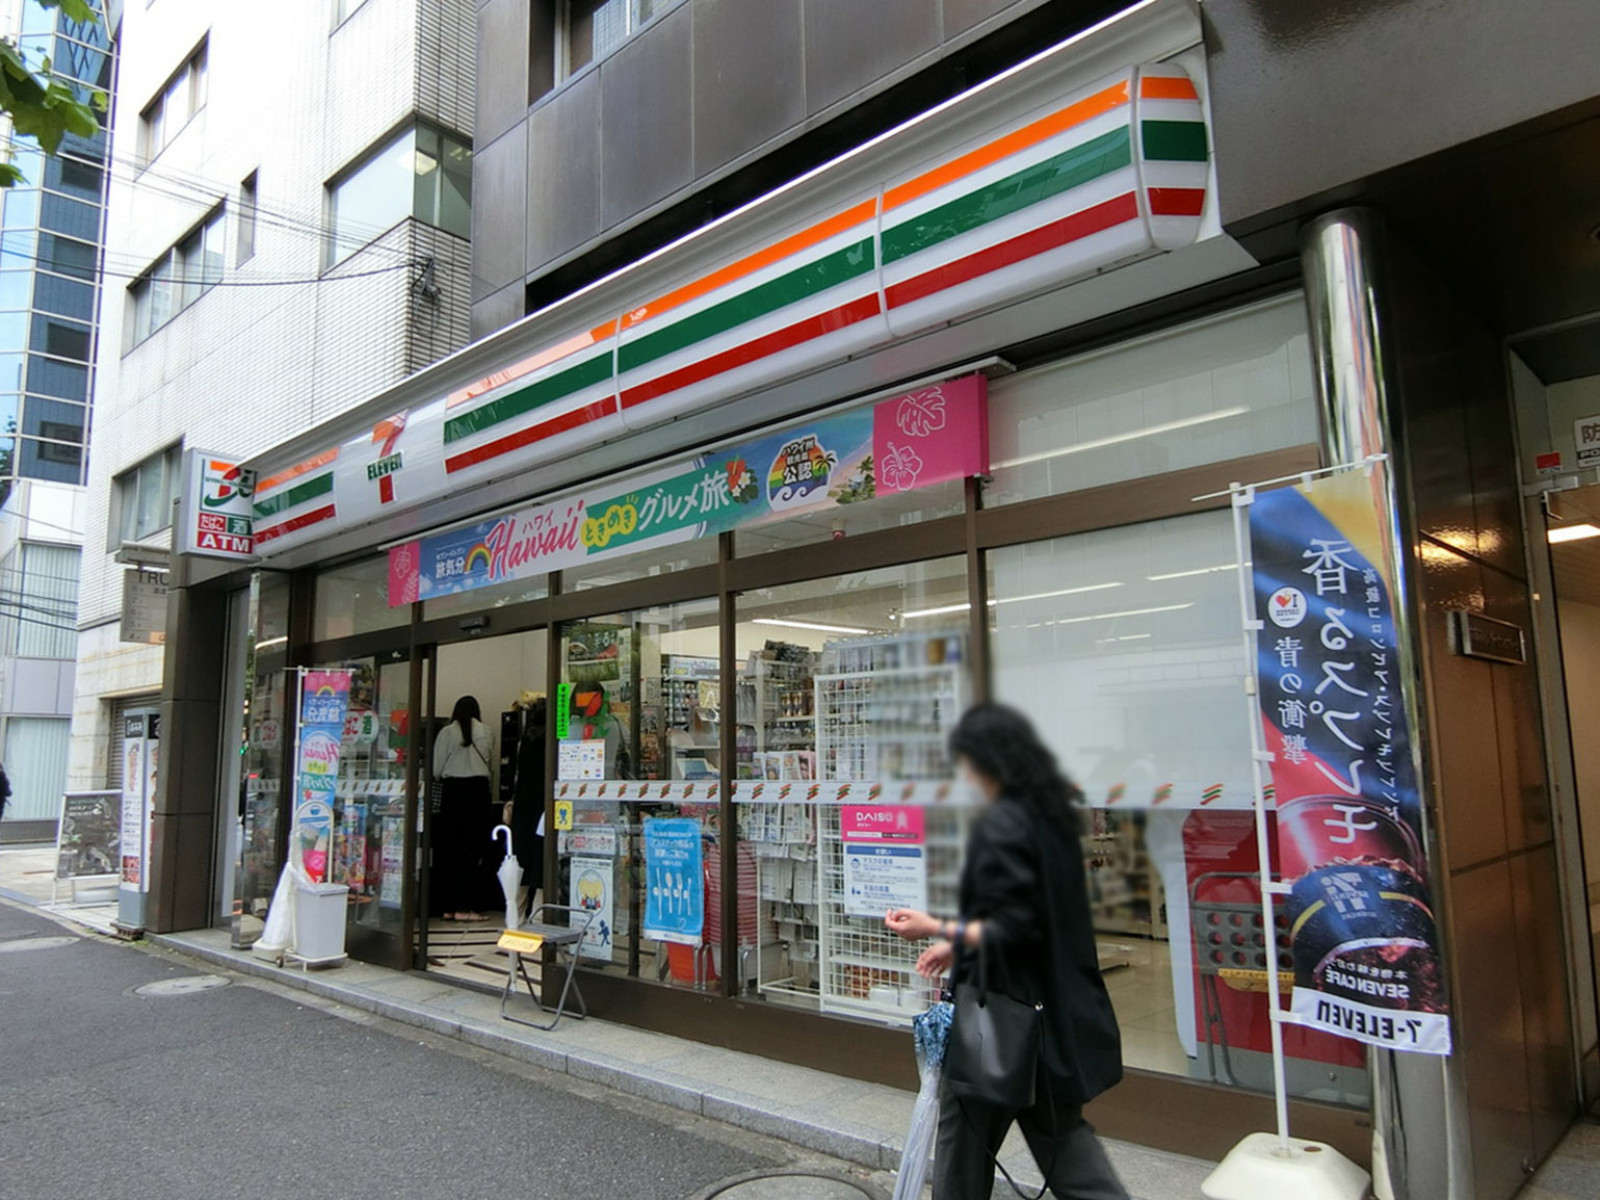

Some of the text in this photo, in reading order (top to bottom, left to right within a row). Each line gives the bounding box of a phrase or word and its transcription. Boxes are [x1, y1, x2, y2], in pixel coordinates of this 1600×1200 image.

[783, 461, 813, 485] 公認
[638, 470, 730, 531] グルメ旅
[522, 509, 554, 533] ハワイ
[201, 534, 249, 552] ATM
[485, 499, 585, 579] Hawaii
[856, 812, 893, 822] DAISO
